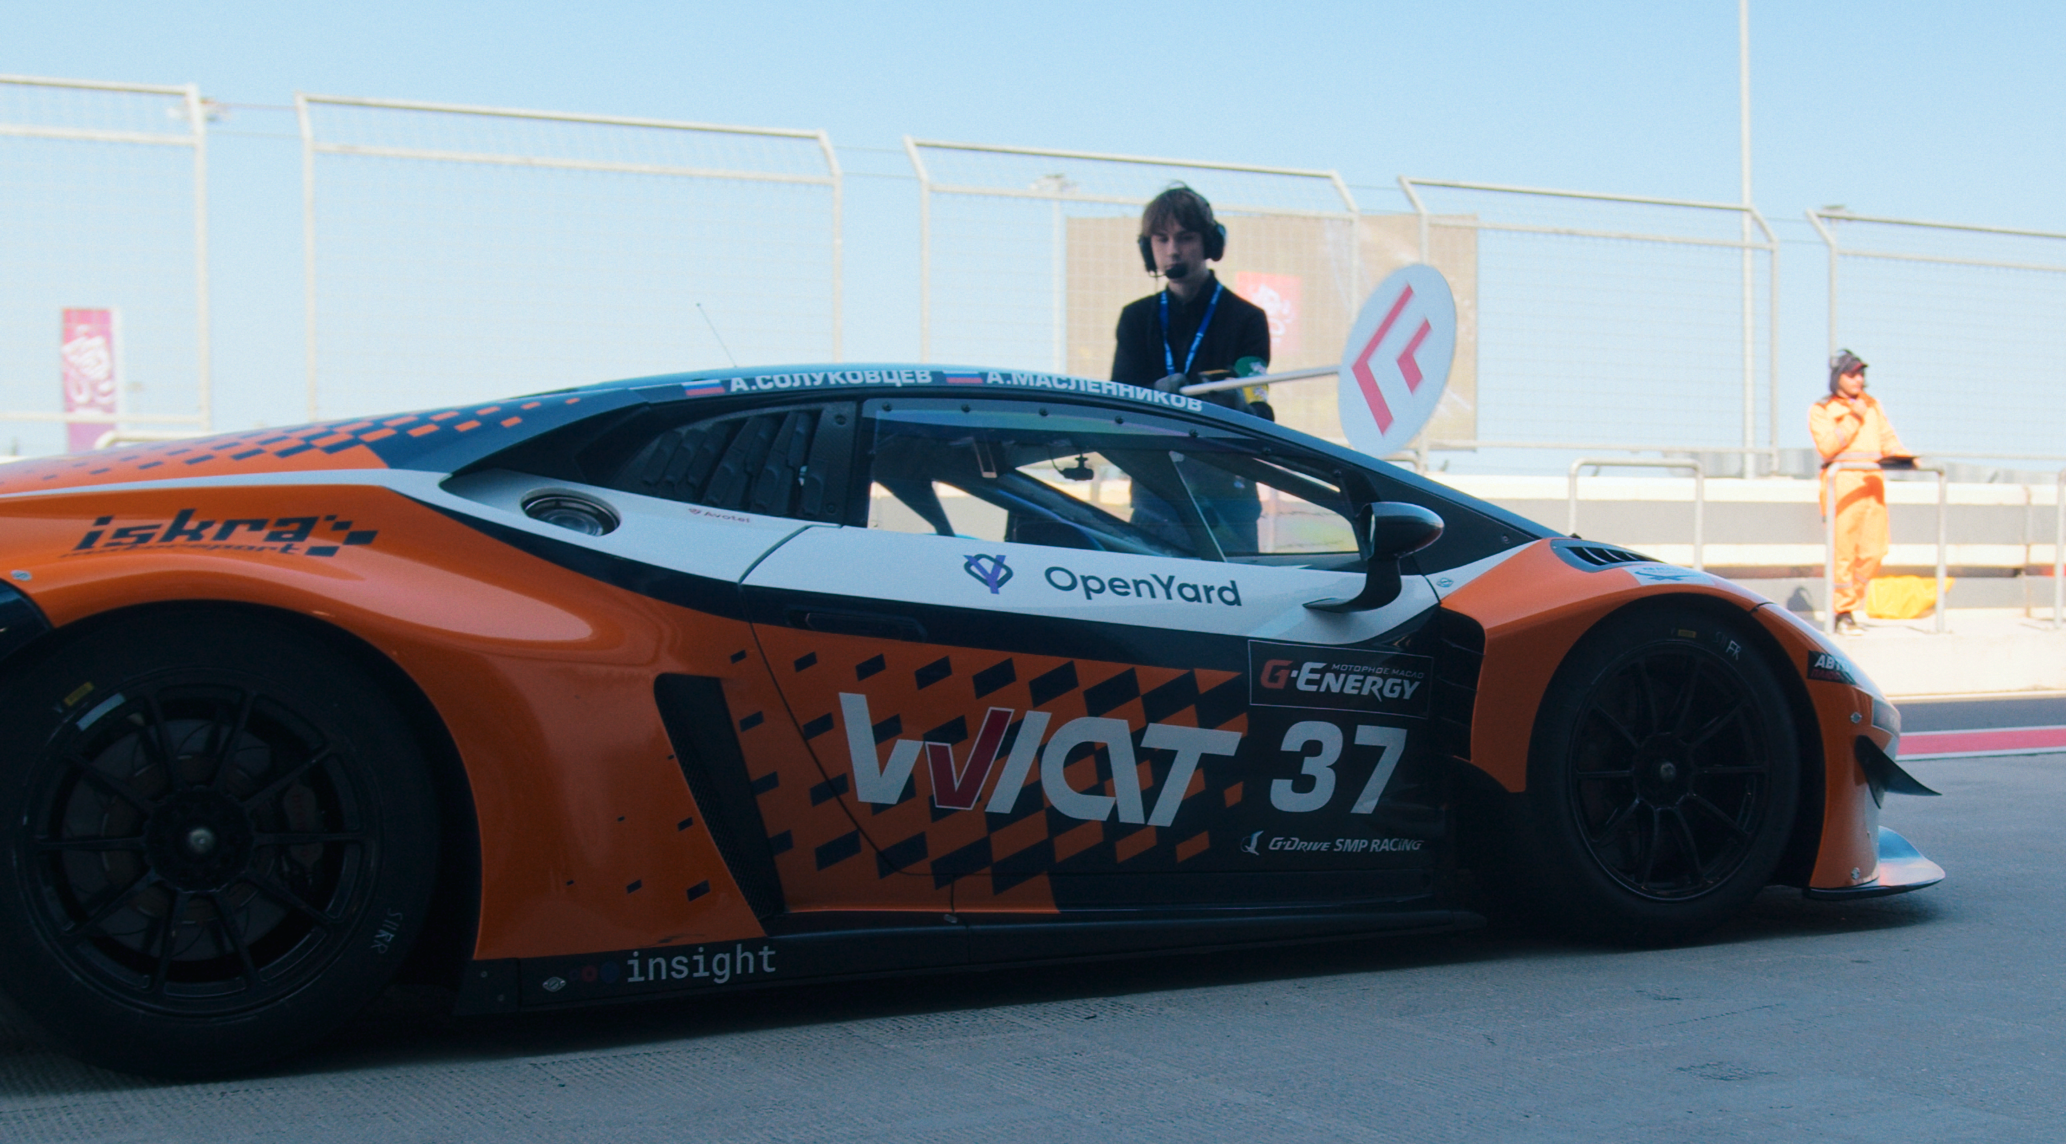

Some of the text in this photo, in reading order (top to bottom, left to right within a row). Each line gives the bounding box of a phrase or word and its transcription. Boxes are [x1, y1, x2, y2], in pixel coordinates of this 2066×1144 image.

[730, 369, 933, 392] А.СОЛУКОВЦЕВ
[985, 371, 1203, 412] А.МАСЛЕННИКОВ
[71, 508, 320, 551] iskra
[1044, 566, 1242, 607] OpenYard
[1270, 720, 1408, 814] 37
[1333, 838, 1368, 852] SMP
[627, 943, 776, 984] insight
